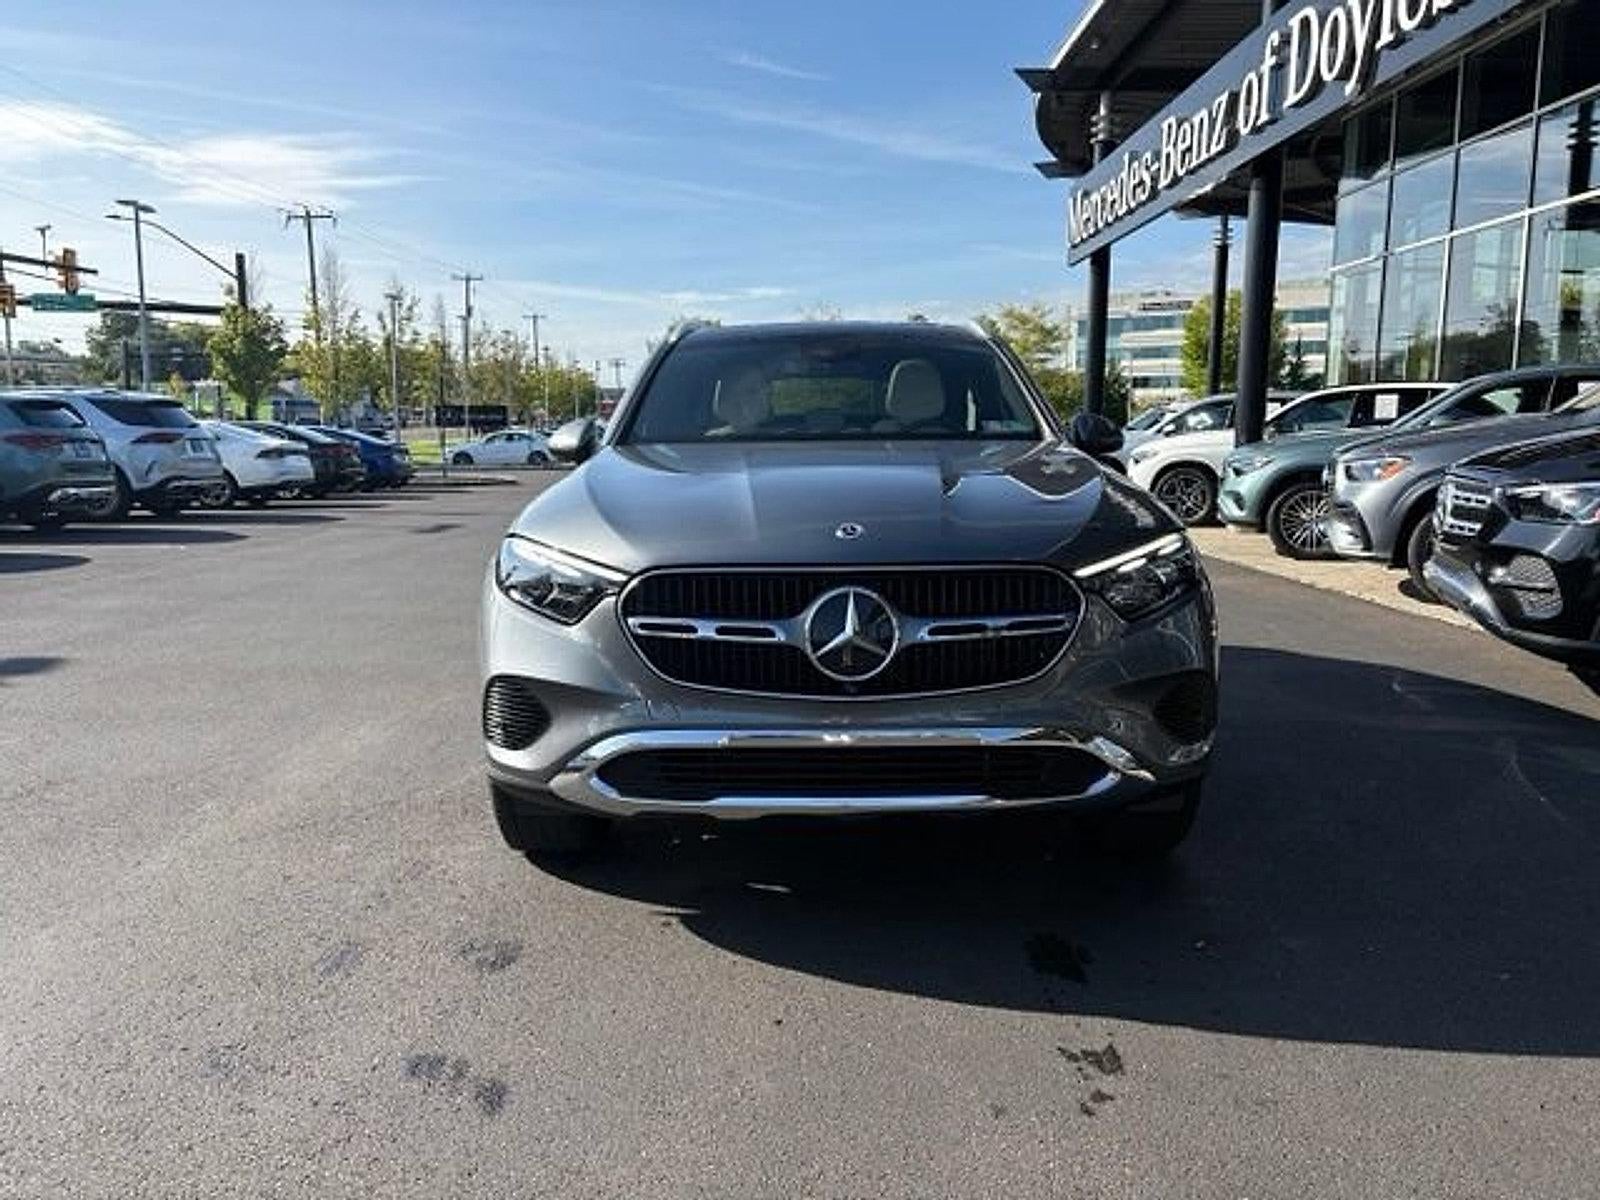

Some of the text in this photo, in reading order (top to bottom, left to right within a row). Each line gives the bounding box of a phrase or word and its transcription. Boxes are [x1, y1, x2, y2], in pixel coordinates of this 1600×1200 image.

[1068, 0, 1451, 245] Mercedes-Benz of Doy
